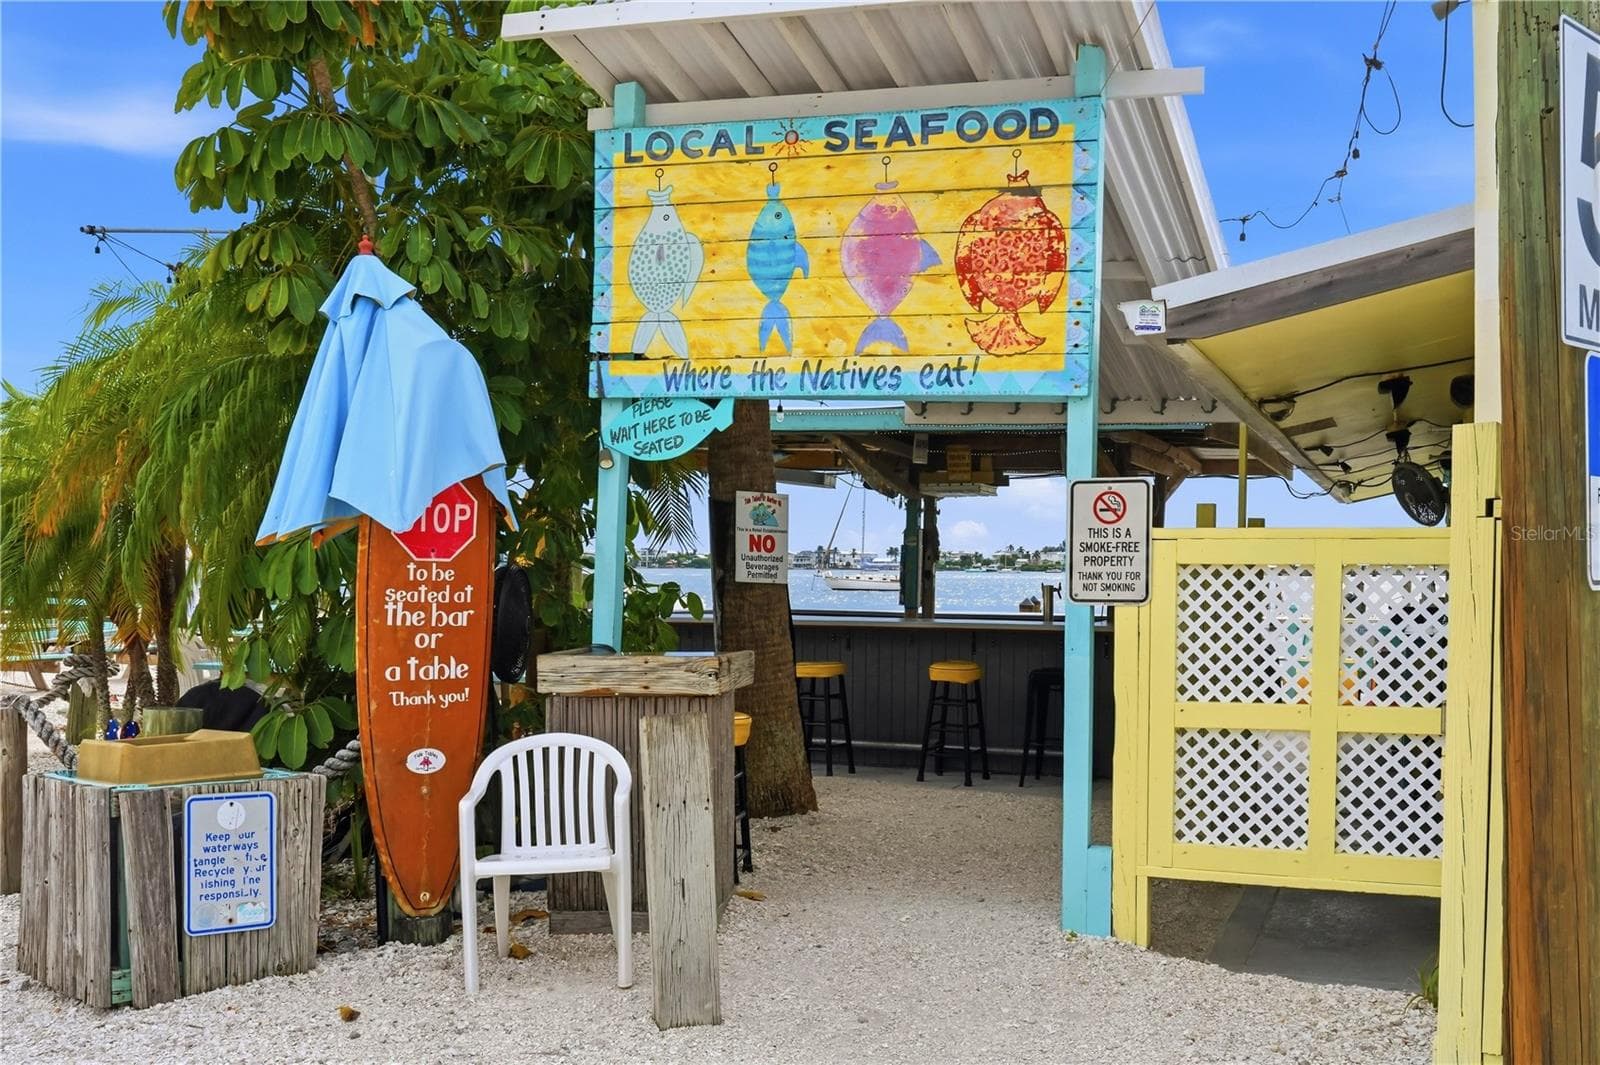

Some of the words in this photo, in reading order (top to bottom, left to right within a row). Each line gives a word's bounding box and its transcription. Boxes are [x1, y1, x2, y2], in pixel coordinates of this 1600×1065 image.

[623, 125, 765, 164] LOCAL
[823, 107, 1060, 153] SEAFOOD
[662, 360, 732, 392] Where
[747, 360, 788, 392] the
[799, 359, 903, 392] Natives
[918, 355, 981, 389] eat!
[631, 397, 674, 418] PLEASE
[609, 423, 640, 445] WAIT
[643, 415, 677, 435] HERE
[679, 410, 694, 427] TO
[695, 408, 712, 424] BE
[633, 435, 684, 456] SEATED
[420, 502, 472, 534] TOP
[1088, 527, 1109, 539] THIS
[1112, 527, 1122, 538] IS
[1124, 527, 1132, 538] A
[749, 534, 776, 553] NO
[1079, 541, 1140, 553] SMOKE-FREE
[741, 553, 784, 562] Unauthorized
[1083, 555, 1135, 567] PROPERTY
[406, 562, 428, 581] to
[432, 562, 455, 581] be
[745, 561, 779, 572] Beverages
[747, 570, 778, 579] Permitted
[1078, 571, 1104, 581] THANK
[1106, 571, 1123, 581] YOU
[1125, 571, 1141, 581] FOR
[384, 584, 451, 603] seated
[453, 584, 474, 603] at
[1082, 582, 1098, 593] NOT
[1101, 582, 1136, 593] SMOKING
[384, 601, 426, 627] the
[431, 602, 475, 627] bar
[414, 632, 444, 649] or
[384, 666, 401, 681] a
[406, 655, 469, 681] table
[388, 688, 436, 707] Thank
[439, 687, 470, 709] you!
[205, 832, 231, 843] Keep
[202, 842, 259, 854] waterways
[193, 855, 226, 869] tangle
[194, 867, 236, 878] Recycle
[243, 863, 267, 874] yur
[243, 875, 261, 884] lne
[199, 889, 262, 902] responsily.
